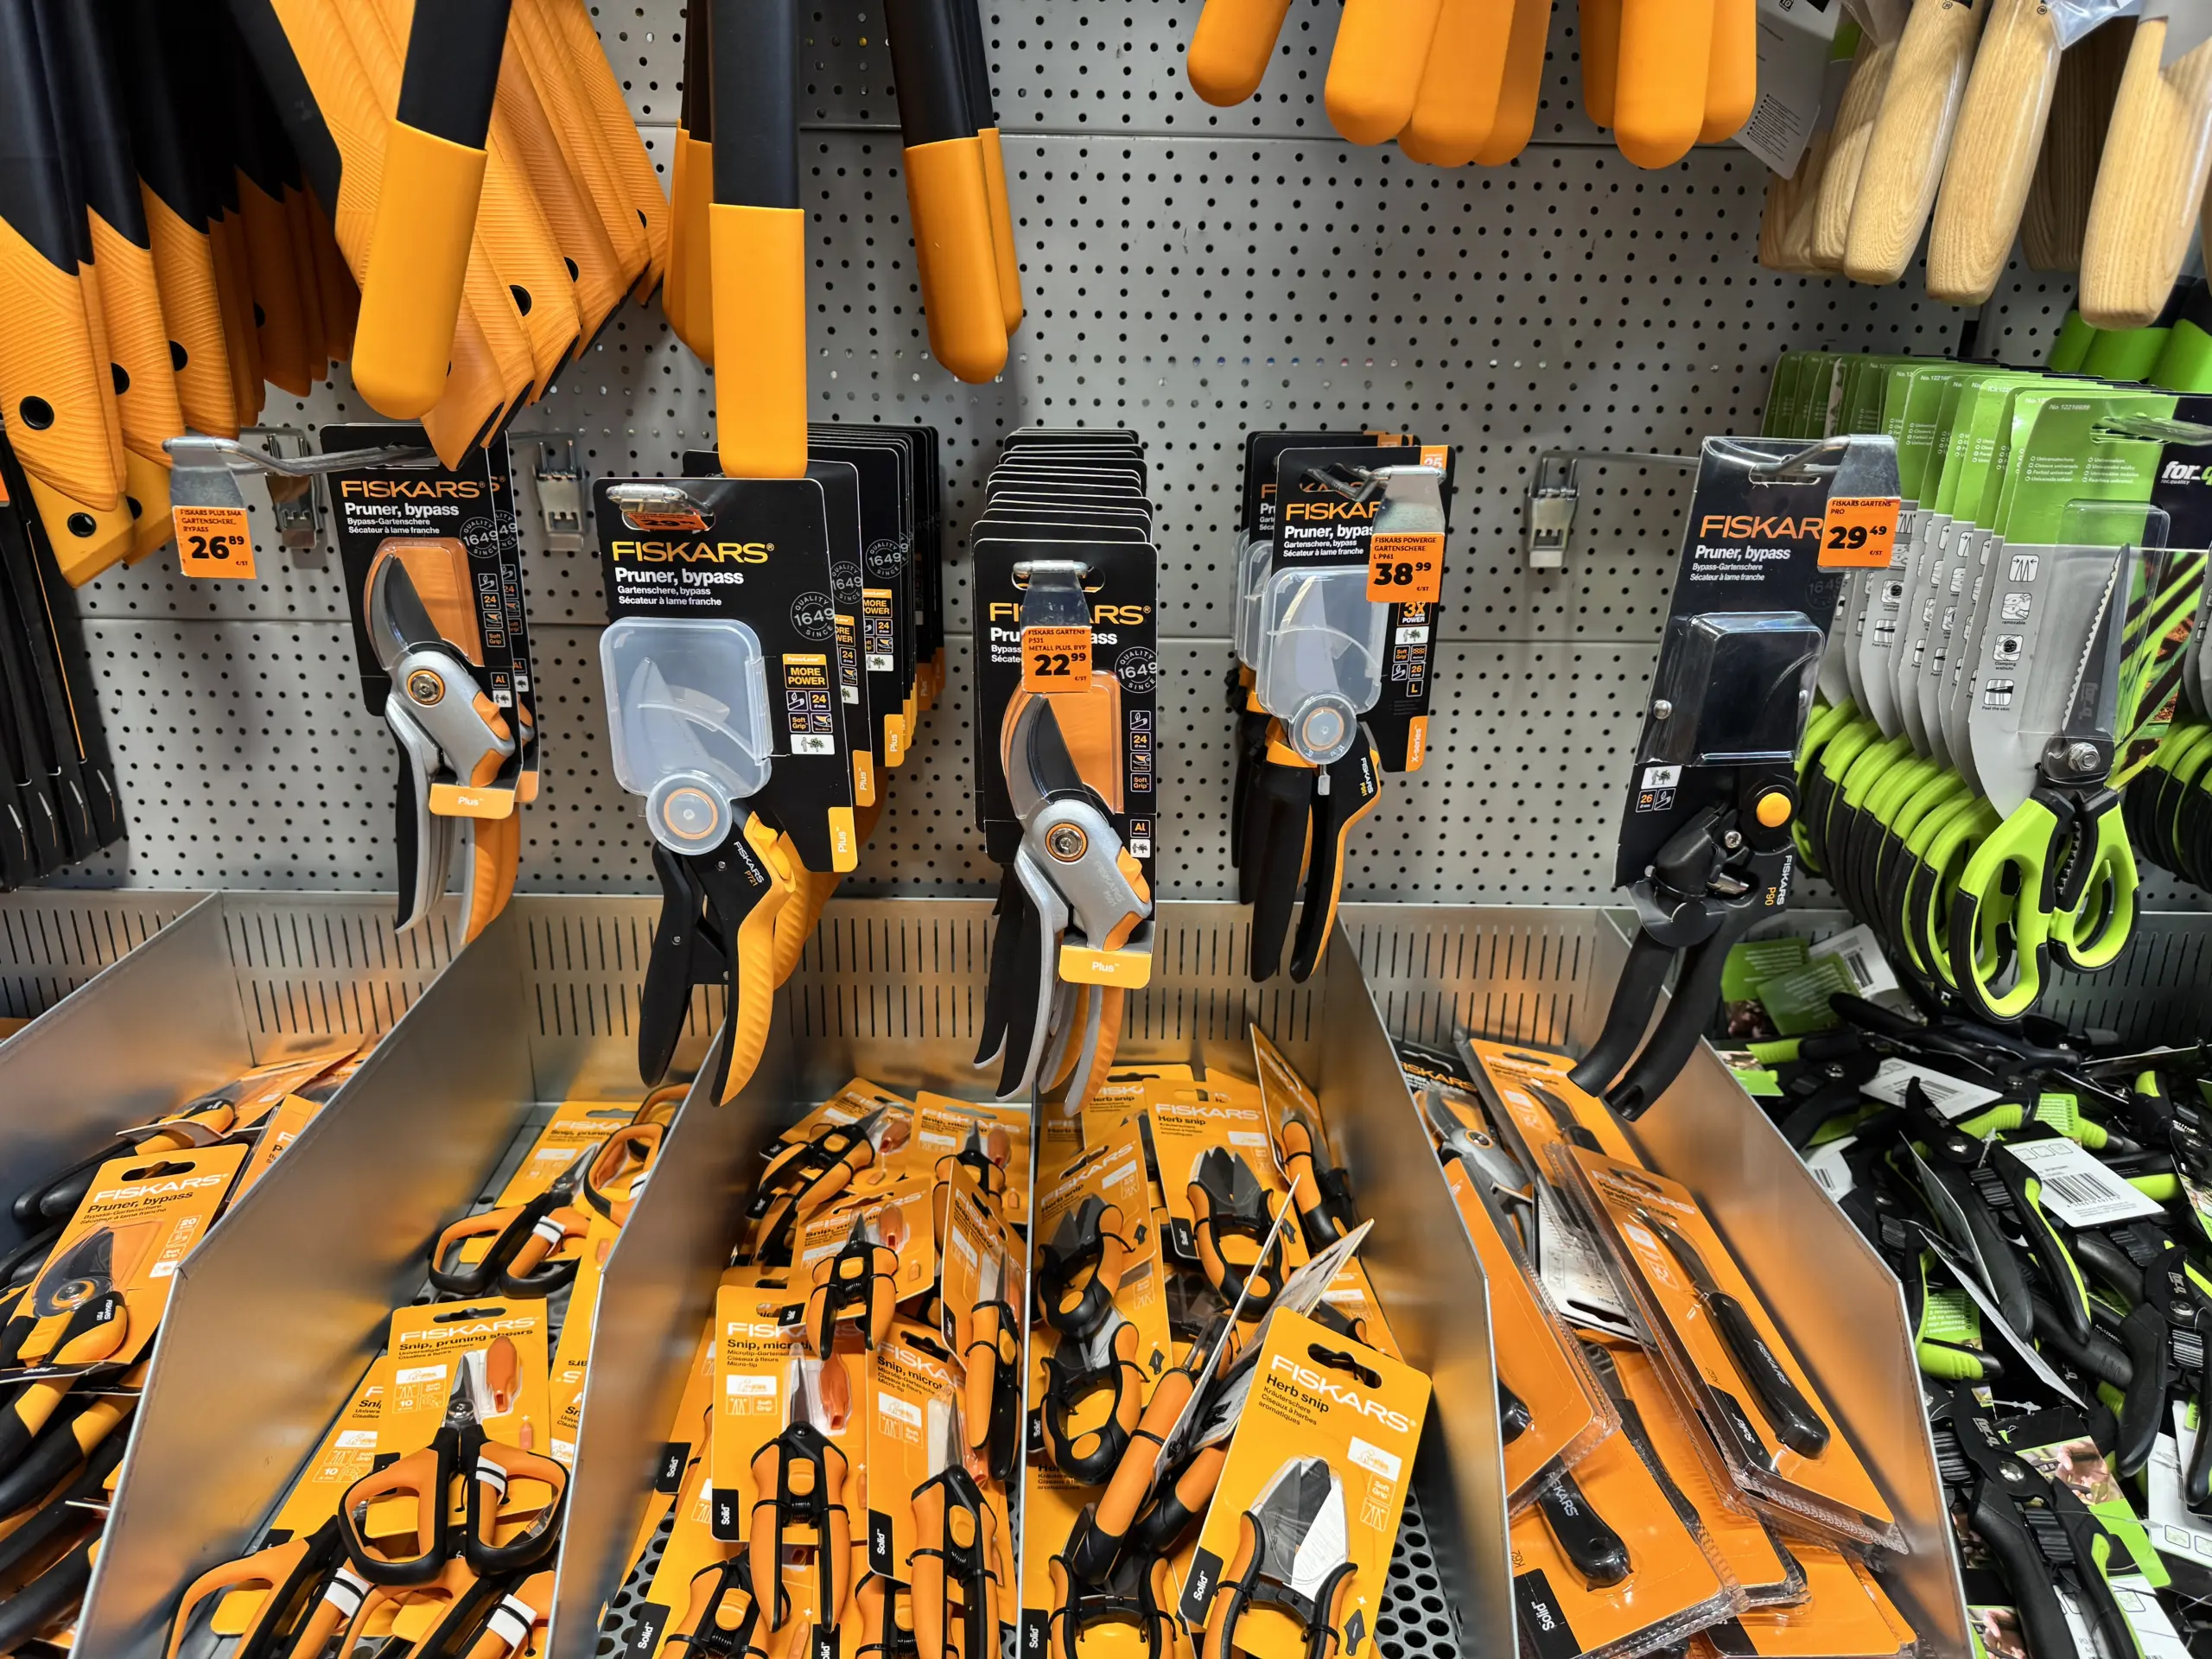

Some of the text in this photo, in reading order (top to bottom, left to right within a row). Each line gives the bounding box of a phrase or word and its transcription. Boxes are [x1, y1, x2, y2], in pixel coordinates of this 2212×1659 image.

[345, 503, 460, 518] Pruner, bypass
[463, 520, 493, 534] QUALITY
[1284, 525, 1333, 539] Pruner,
[1700, 515, 1825, 539] FISKAR
[463, 531, 498, 546] 1649
[1333, 539, 1357, 548] bypass
[1827, 525, 1887, 550] 29 49
[188, 536, 245, 560] 26 89
[474, 544, 498, 556] SINCE
[870, 542, 897, 555] QUALITY
[1320, 548, 1336, 556] lame
[1695, 545, 1790, 562] Pruner, bypass
[868, 553, 900, 567] 1649
[1693, 563, 1763, 571] Bypass-Gartenschere
[615, 567, 744, 586] Pruner, bypass
[832, 563, 858, 577] QUALITY
[876, 566, 899, 575] SINCE
[1374, 563, 1431, 586] 38 99
[1690, 572, 1718, 581] Sécateur
[832, 575, 862, 591] 1649
[618, 586, 711, 596] Gartenschere, bypass
[840, 591, 861, 601] SINCE
[619, 595, 722, 605] Sécateur lame franche
[795, 594, 830, 611] QUALITY
[794, 608, 835, 626] 1649
[805, 625, 833, 638] SINCE
[1034, 653, 1087, 676] 22 99
[1120, 650, 1154, 665] QUALITY
[790, 667, 821, 676] MORE
[1118, 662, 1157, 679] 1649
[788, 677, 826, 685] POWER
[1128, 677, 1156, 690] SINCE
[1412, 684, 1418, 693] L
[812, 695, 826, 703] 24
[1361, 757, 1374, 793] FISKARS
[1642, 795, 1654, 804] 26
[734, 841, 764, 883] FISKARS
[744, 869, 757, 887] P721
[1777, 855, 1792, 906] FISKARS
[1764, 887, 1777, 906] P90
[1158, 1115, 1182, 1123] Herb
[1065, 1184, 1084, 1200] snip
[86, 1191, 194, 1213] Pruner, bypass
[104, 1300, 113, 1320] FISKARS
[399, 1341, 433, 1351] Snip,
[436, 1334, 487, 1347] pruning
[728, 1339, 760, 1350] Snip,
[878, 1356, 906, 1376] Snip,
[1263, 1386, 1311, 1414] Kräuterschere
[1267, 1374, 1329, 1414] Herb snip
[1258, 1401, 1300, 1426] aromatiques
[1262, 1394, 1317, 1426] Ciseaux herbes
[1374, 1480, 1389, 1491] Soft
